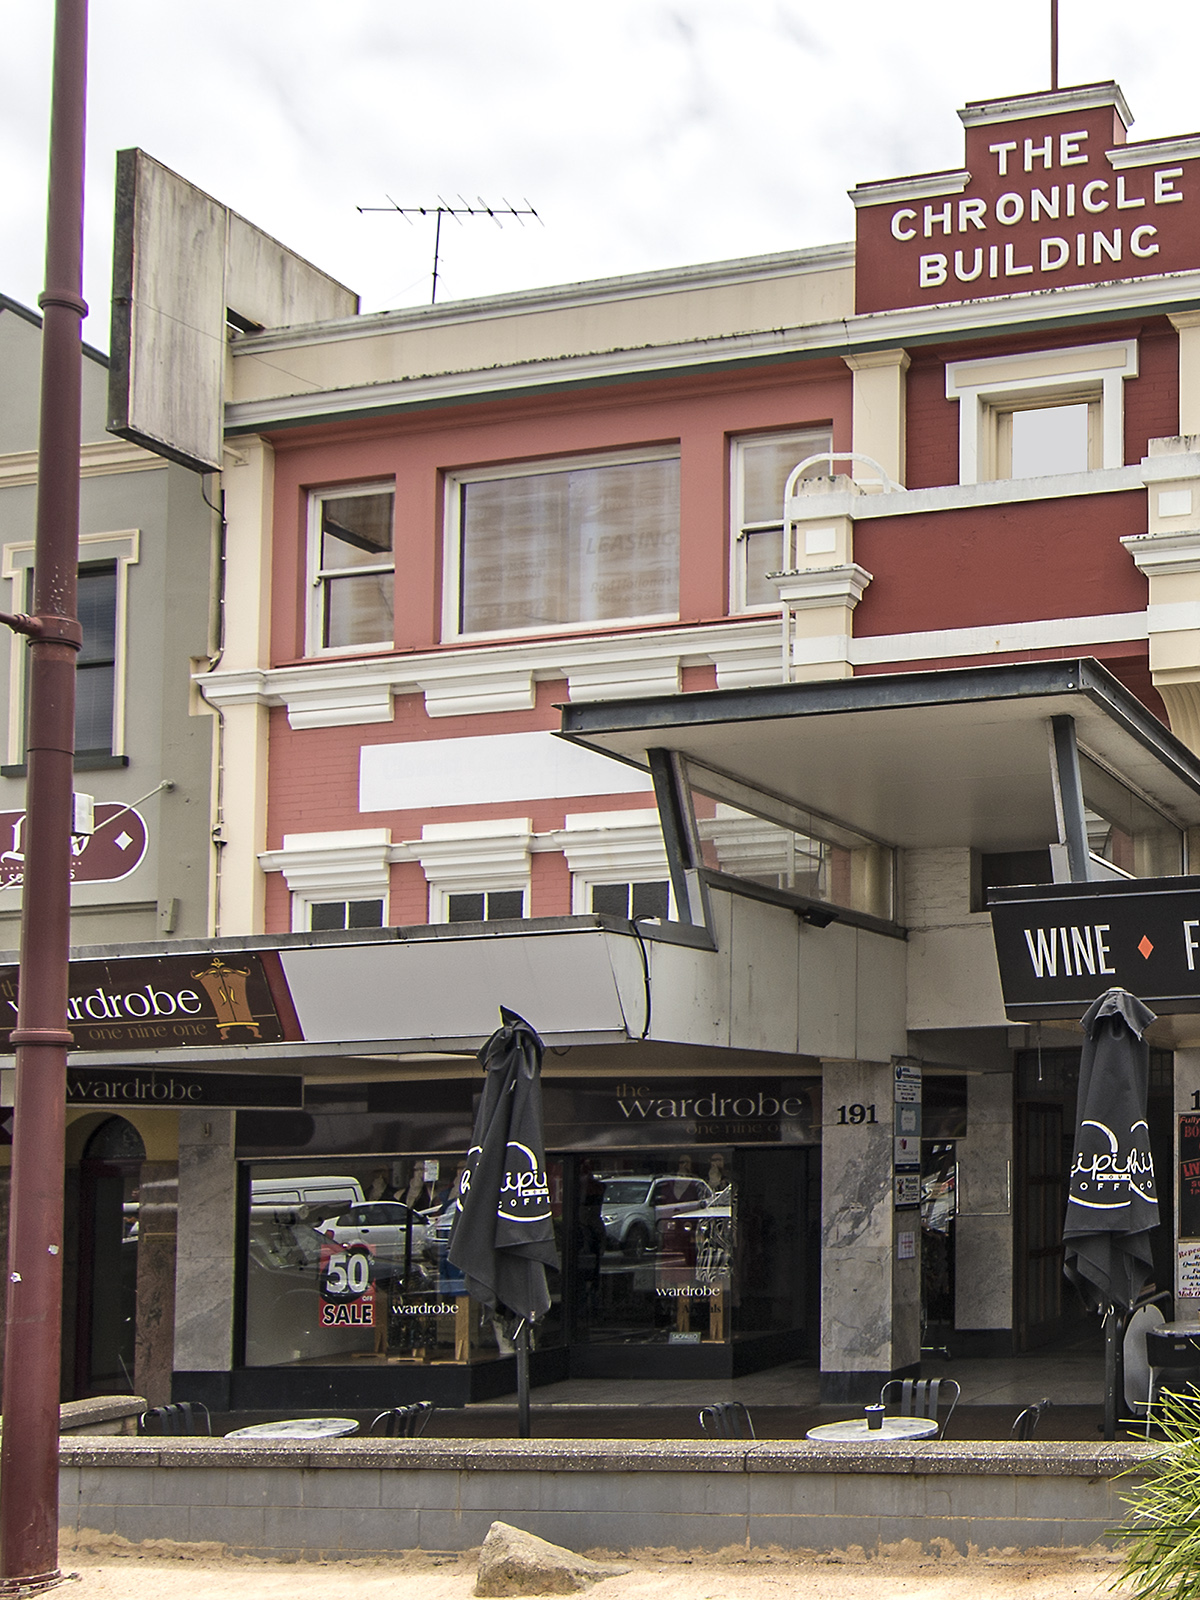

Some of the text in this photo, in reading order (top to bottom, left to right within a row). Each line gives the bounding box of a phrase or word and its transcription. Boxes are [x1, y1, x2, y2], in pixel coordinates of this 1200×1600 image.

[989, 130, 1089, 176] THE
[891, 167, 1184, 241] CHRONICLE
[919, 224, 1160, 289] BUILDING
[585, 529, 678, 555] LEASING
[1023, 924, 1116, 978] WINE
[89, 1021, 209, 1041] one nine one
[66, 1078, 203, 1101] wardrobe
[615, 1083, 650, 1098] the
[617, 1092, 802, 1118] wardrobe
[837, 1104, 879, 1125] 191
[685, 1122, 720, 1136] one
[725, 1120, 763, 1134] nine
[1180, 1116, 1200, 1125] Fully
[655, 1285, 720, 1297] wardrobe
[322, 1303, 372, 1325] SALE
[392, 1302, 459, 1315] wardrobe
